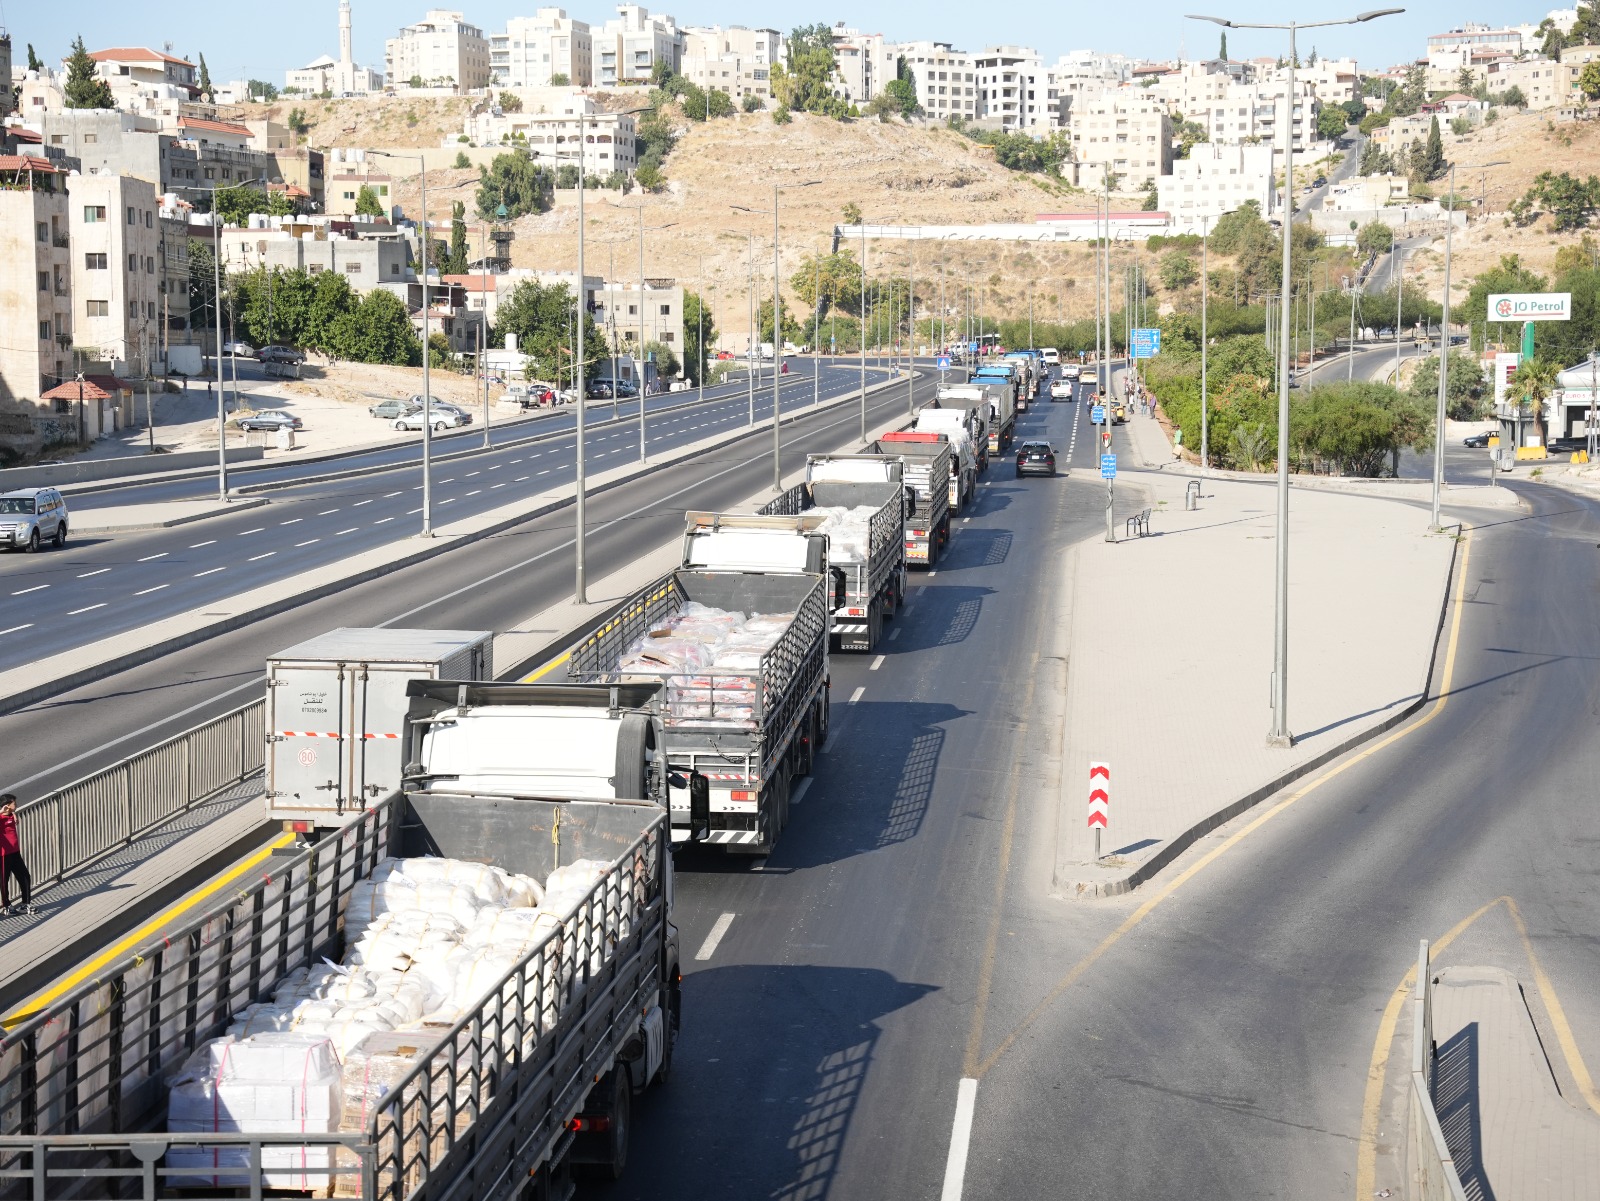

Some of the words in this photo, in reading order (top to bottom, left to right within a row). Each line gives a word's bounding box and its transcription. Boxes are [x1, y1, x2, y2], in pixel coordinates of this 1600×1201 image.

[1514, 301, 1528, 313] JO
[1531, 300, 1564, 311] Petrol
[302, 752, 312, 762] 80
